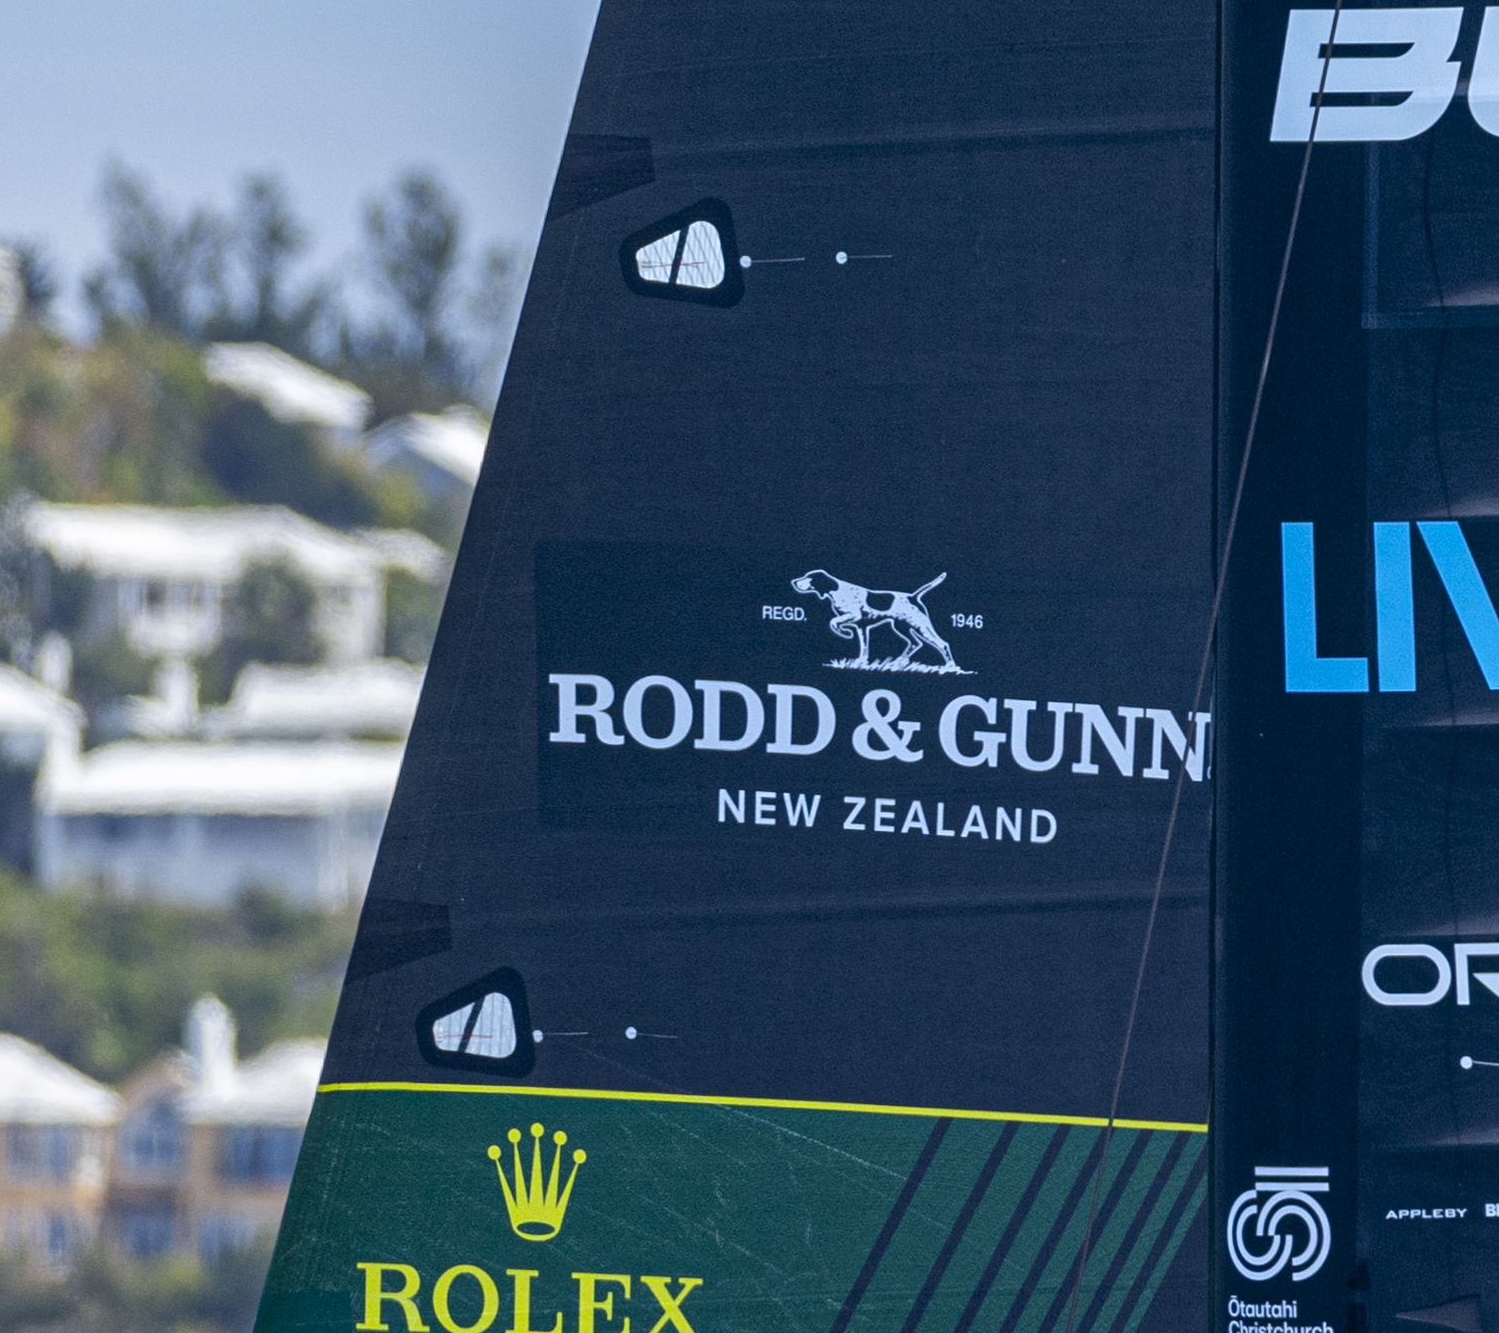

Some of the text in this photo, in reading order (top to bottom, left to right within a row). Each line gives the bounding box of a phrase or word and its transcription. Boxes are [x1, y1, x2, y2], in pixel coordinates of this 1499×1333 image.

[761, 605, 808, 622] REGD.
[951, 613, 984, 629] 1946
[548, 673, 1212, 783] RODD & GUNN
[717, 789, 1059, 845] NEW ZEALAND
[1385, 1207, 1468, 1220] APPLEBY
[1227, 1294, 1298, 1318] Ōtautahi
